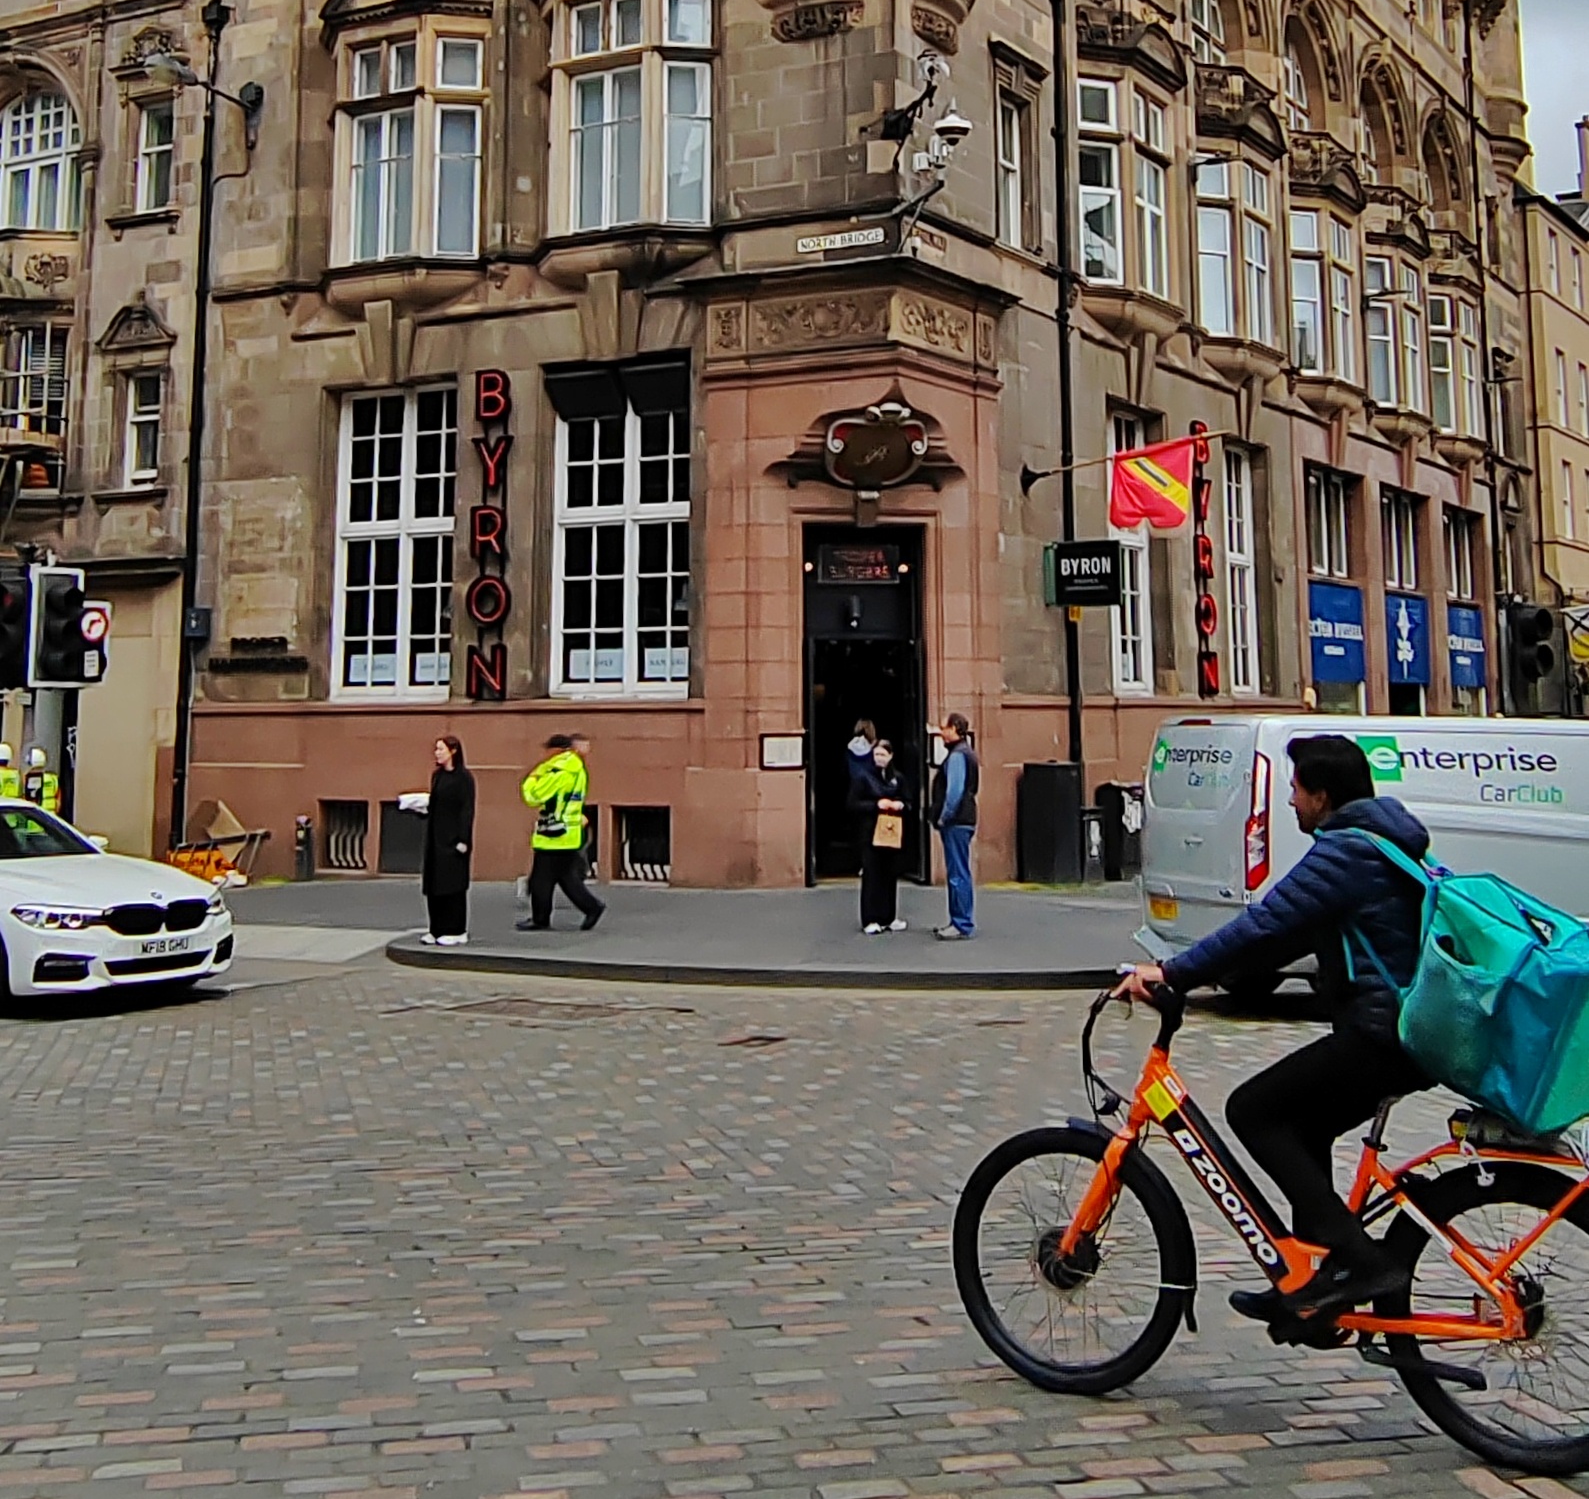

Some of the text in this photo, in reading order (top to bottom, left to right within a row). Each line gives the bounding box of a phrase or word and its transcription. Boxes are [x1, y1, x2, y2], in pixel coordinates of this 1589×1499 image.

[800, 229, 883, 250] NORTH BRIDGE
[466, 369, 511, 700] BYRON
[1060, 556, 1111, 576] BYRON
[1155, 744, 1233, 768] enterprise
[1370, 746, 1558, 778] enterprise
[1480, 784, 1563, 803] CarClub
[1192, 1154, 1278, 1265] zoomo
